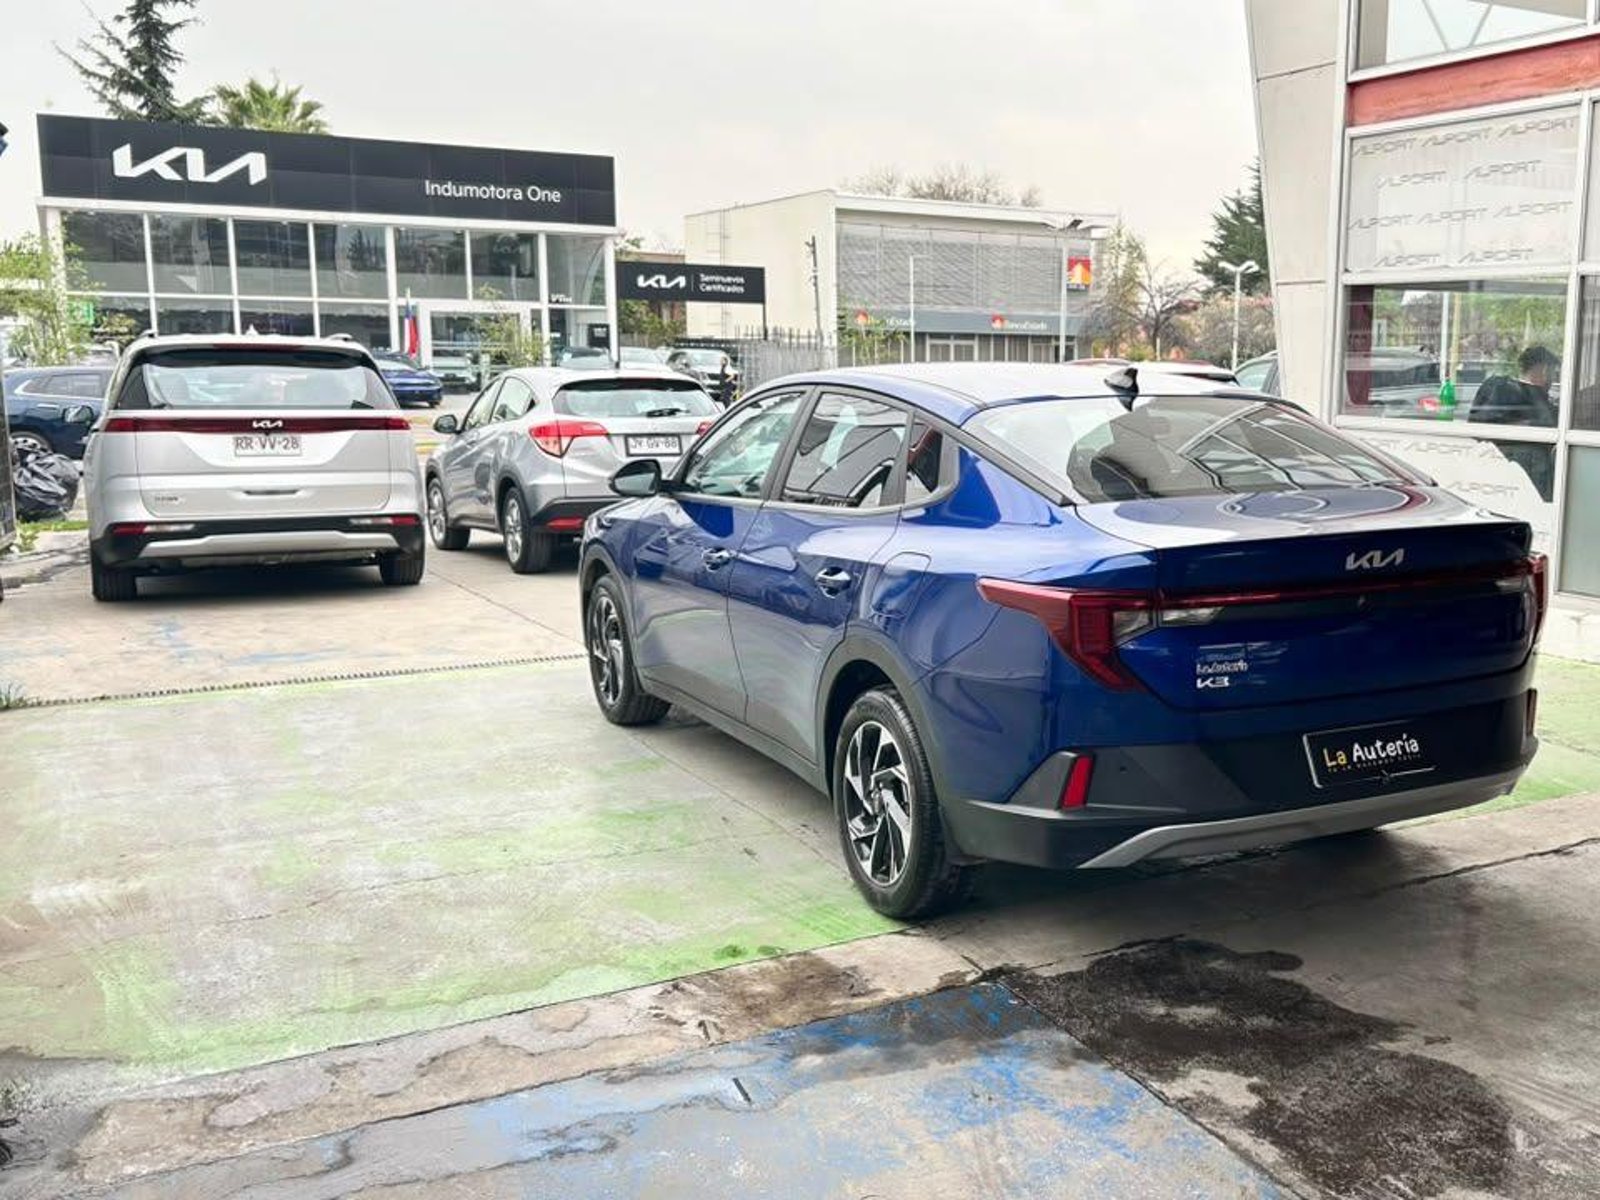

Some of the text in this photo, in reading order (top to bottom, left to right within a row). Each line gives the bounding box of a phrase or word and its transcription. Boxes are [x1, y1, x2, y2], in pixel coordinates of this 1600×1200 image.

[1421, 127, 1491, 148] ALPORT
[1498, 115, 1580, 139] ALPORT
[112, 143, 267, 186] KIA
[1463, 159, 1541, 180] ALPORT
[424, 178, 562, 203] Indumotora One
[636, 274, 687, 289] KIA
[1345, 548, 1405, 571] KIA
[1322, 747, 1348, 768] La
[1352, 732, 1419, 763] Autería
